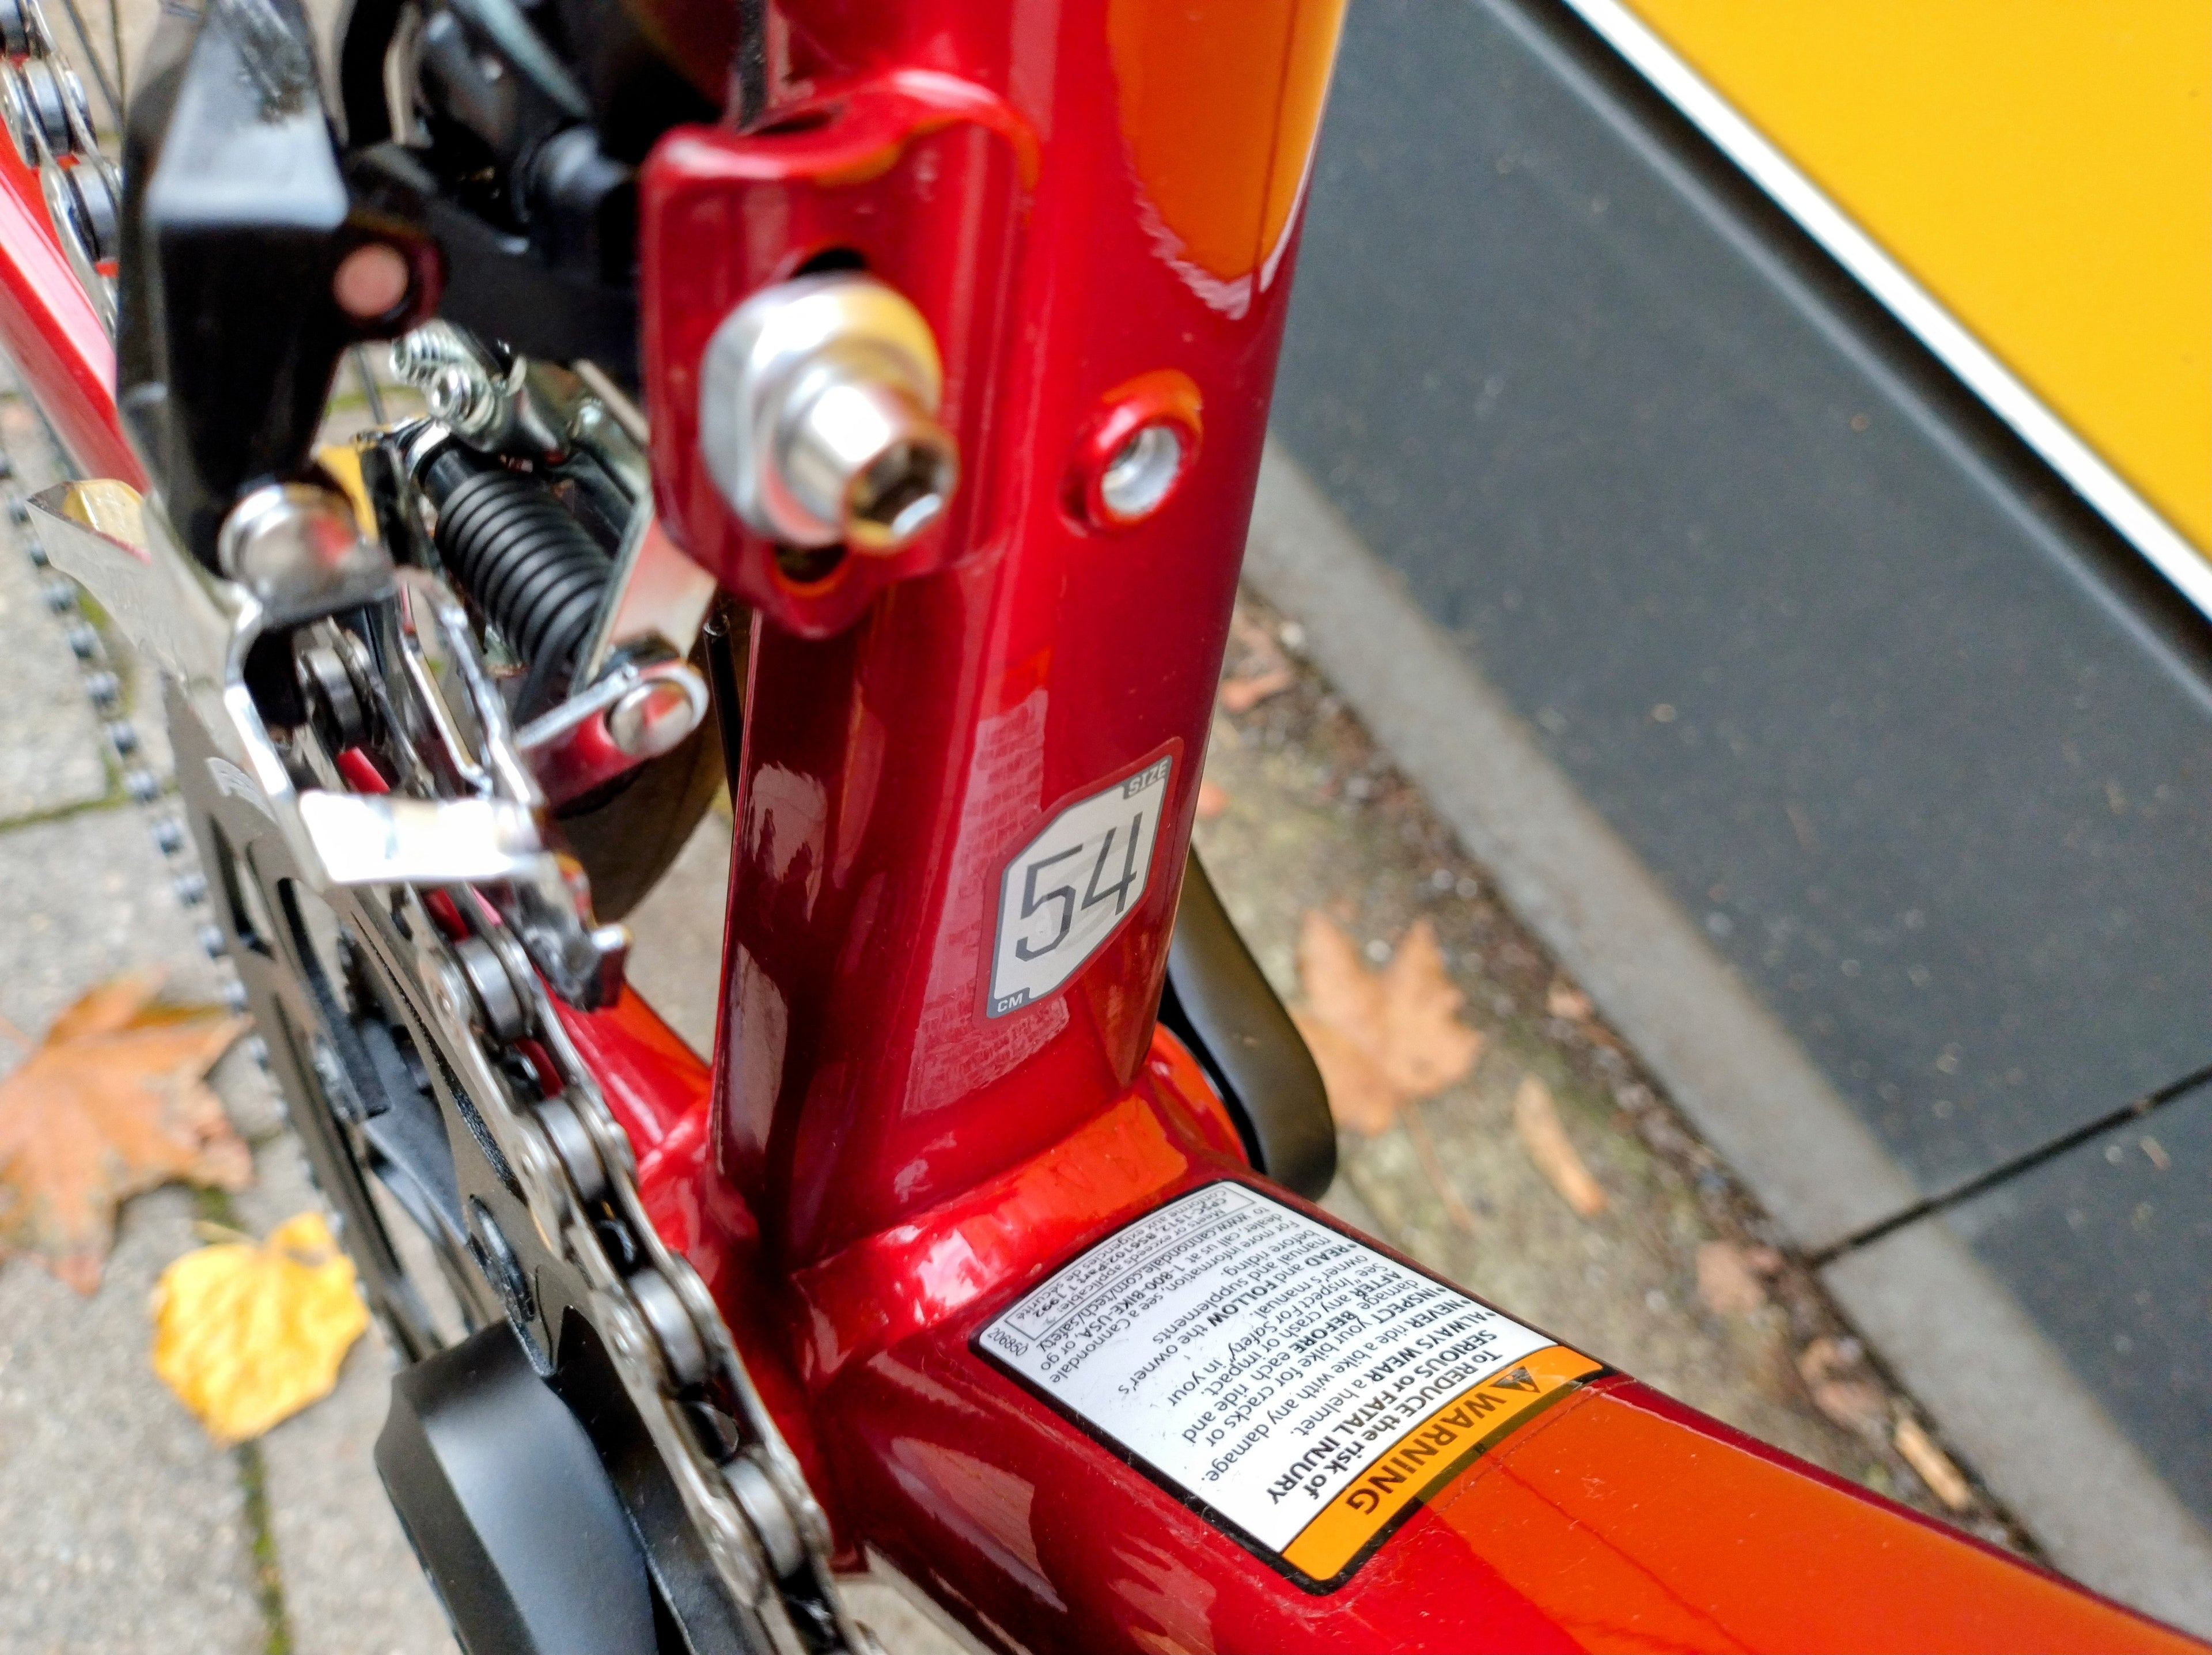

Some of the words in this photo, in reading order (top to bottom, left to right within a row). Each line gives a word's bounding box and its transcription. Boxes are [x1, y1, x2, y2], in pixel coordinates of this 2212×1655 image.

[1128, 760, 1168, 798] SIZE
[1014, 811, 1142, 962] 54
[997, 991, 1024, 1013] CM
[1174, 1226, 1187, 1236] or
[1238, 1213, 1282, 1233] dealer,
[1274, 1220, 1300, 1232] For
[1123, 1234, 1172, 1265] exceeds
[1200, 1244, 1218, 1255] us
[1217, 1232, 1240, 1247] call
[1240, 1229, 1275, 1248] more
[1268, 1229, 1321, 1252] before
[1277, 1237, 1331, 1266] manual
[1160, 1245, 1244, 1291] information,
[1185, 1253, 1202, 1263] at
[1220, 1251, 1270, 1277] riding.
[1304, 1245, 1350, 1266] READ
[1247, 1262, 1278, 1282] and
[1272, 1264, 1304, 1283] and
[1355, 1263, 1388, 1277] See
[1349, 1271, 1402, 1297] AFTER
[1356, 1279, 1418, 1309] damage
[1032, 1293, 1066, 1317] 1992
[1074, 1265, 1185, 1338] 1-800-BIKE-USA,
[1127, 1309, 1139, 1317] a
[1138, 1292, 1163, 1310] see
[1152, 1278, 1249, 1344] supplements
[1206, 1280, 1278, 1327] FOLLOW
[1249, 1281, 1313, 1319] manual.
[1320, 1294, 1351, 1313] any
[1370, 1287, 1441, 1324] INSPECT
[1275, 1305, 1304, 1324] For
[1278, 1311, 1321, 1338] crash
[1404, 1300, 1465, 1328] NEVER
[987, 1327, 1029, 1357] 206850
[1177, 1324, 1208, 1344] the
[1288, 1310, 1358, 1354] BEFORE
[1332, 1316, 1373, 1345] your
[1374, 1324, 1408, 1343] ride
[1415, 1312, 1487, 1349] ALWAYS
[1050, 1318, 1131, 1383] Cannondale
[1060, 1340, 1076, 1355] or
[1261, 1338, 1280, 1353] or
[1297, 1342, 1340, 1367] bike
[1363, 1342, 1378, 1351] a
[1414, 1330, 1497, 1378] SERIOUS
[1471, 1350, 1503, 1363] To
[1040, 1352, 1059, 1370] go
[1200, 1351, 1266, 1396] impact.
[1202, 1359, 1226, 1373] in
[1250, 1352, 1290, 1380] each
[1331, 1349, 1372, 1373] bike
[1363, 1347, 1422, 1381] WEAR
[1167, 1370, 1206, 1407] your
[1274, 1367, 1304, 1387] for
[1296, 1373, 1335, 1399] with
[1351, 1379, 1367, 1388] a
[1392, 1375, 1415, 1392] or
[1394, 1362, 1479, 1418] REDUCE
[1214, 1383, 1249, 1411] ride
[1224, 1386, 1274, 1428] cracks
[1267, 1399, 1299, 1425] any
[1290, 1388, 1359, 1436] helmet.
[1331, 1390, 1398, 1434] FATAL
[1181, 1411, 1216, 1444] and
[1206, 1429, 1225, 1447] or
[1361, 1415, 1400, 1441] the
[1201, 1423, 1269, 1481] damage.
[1323, 1441, 1365, 1474] risk
[1344, 1392, 1506, 1515] WARNING
[1267, 1436, 1340, 1505] INJURY
[1302, 1474, 1327, 1500] of
